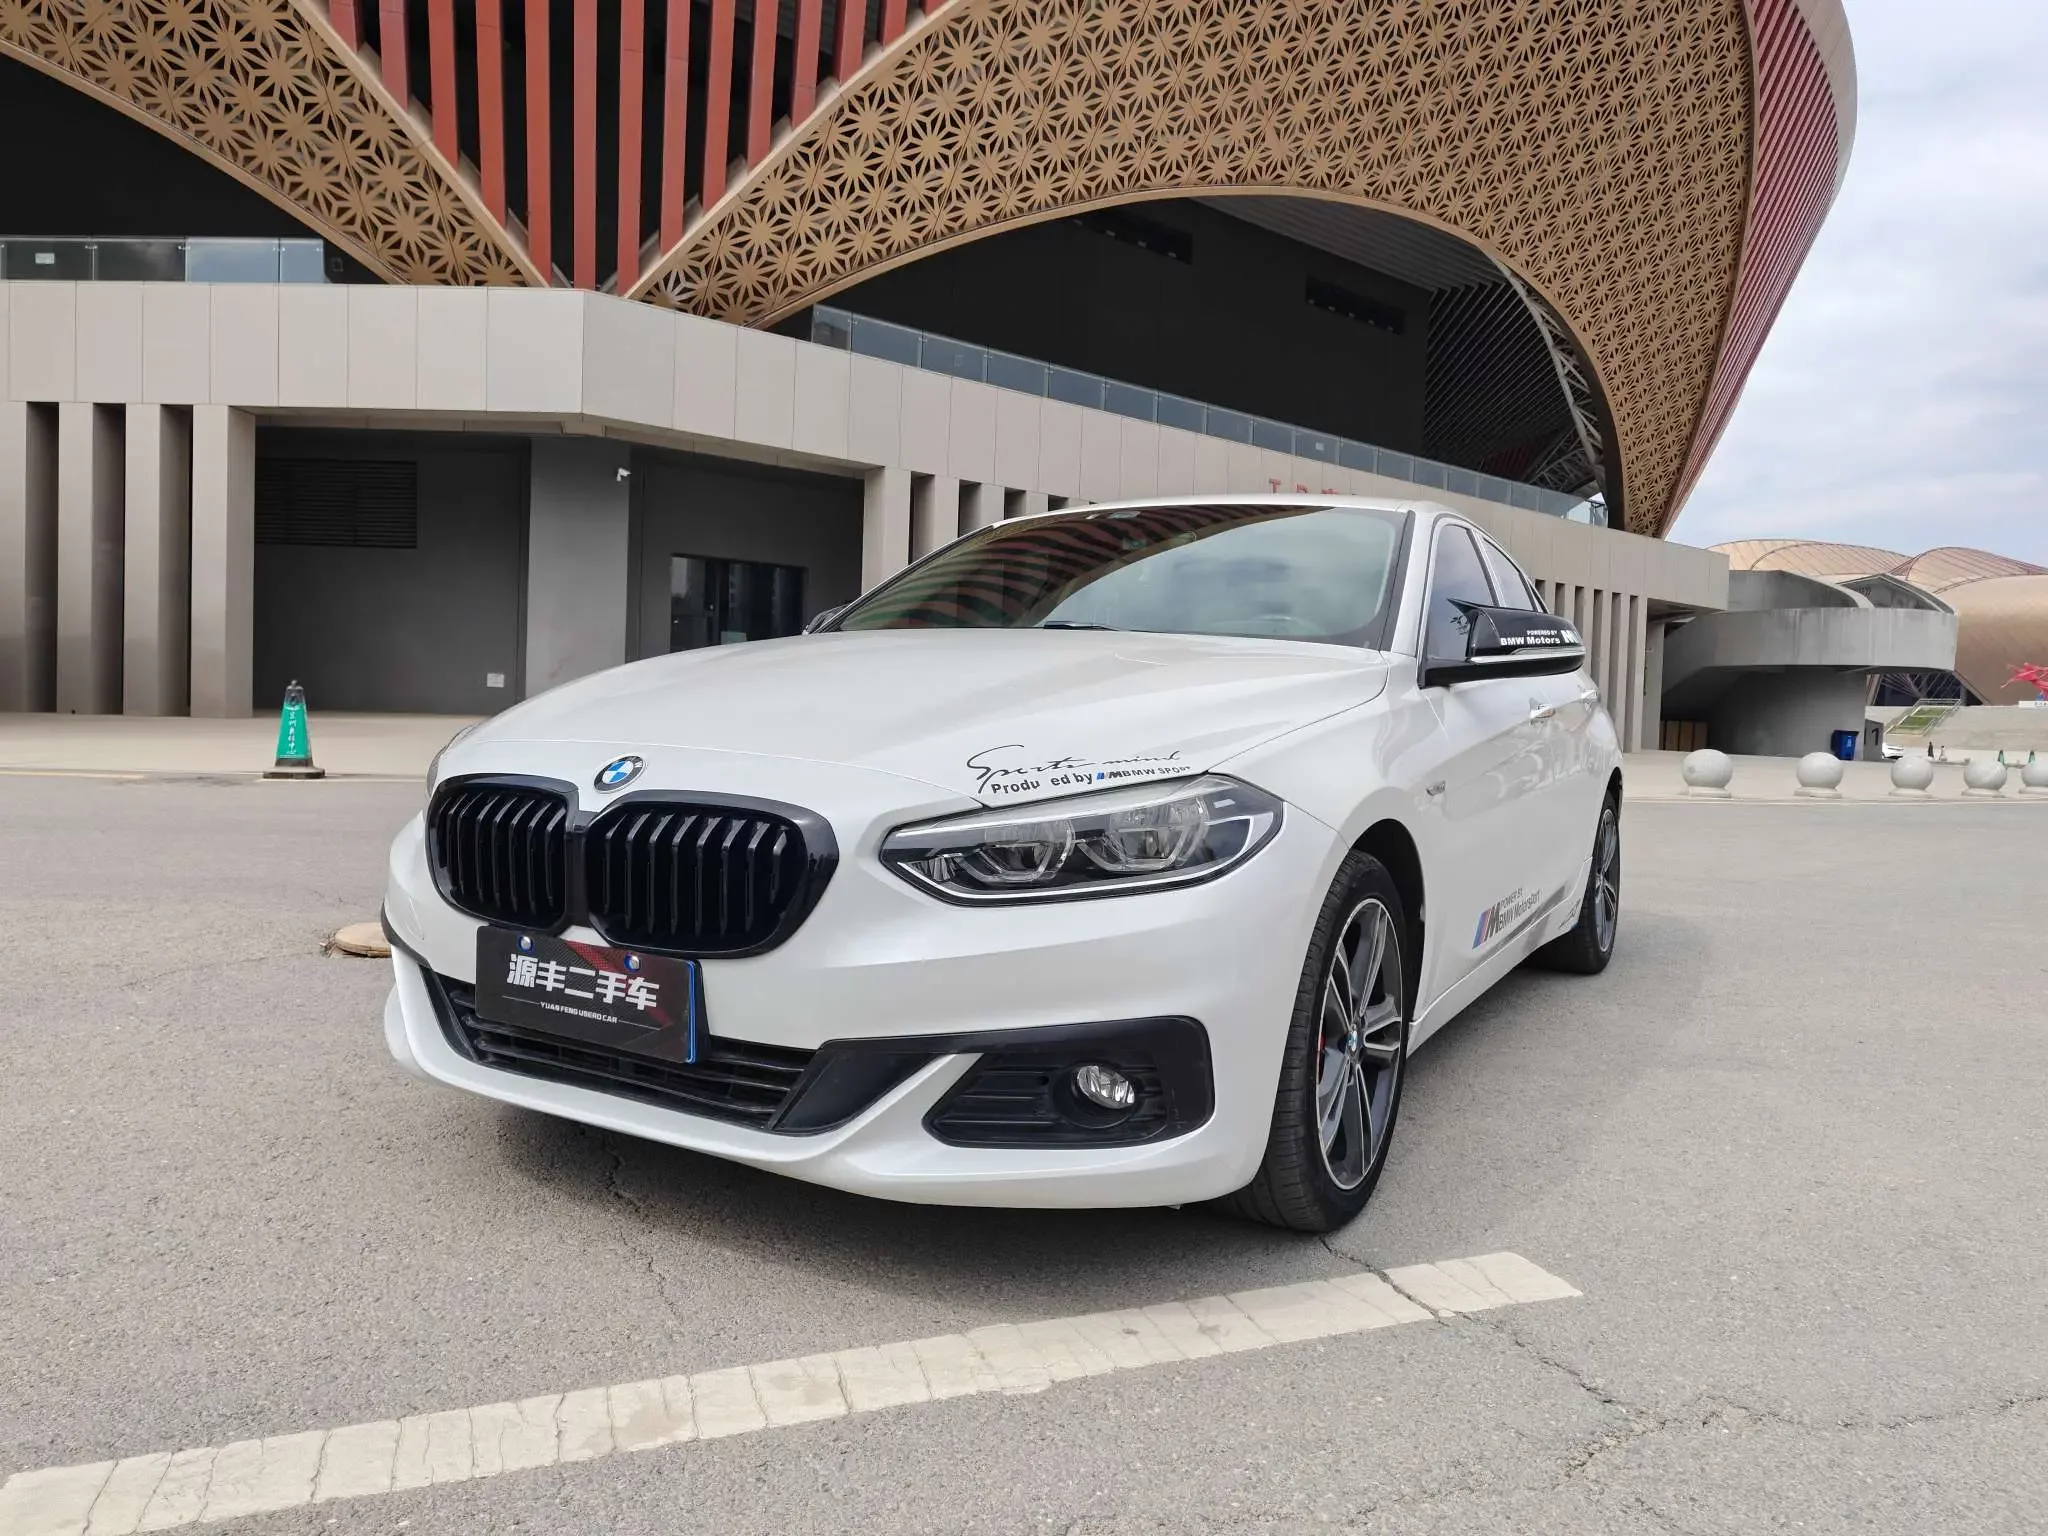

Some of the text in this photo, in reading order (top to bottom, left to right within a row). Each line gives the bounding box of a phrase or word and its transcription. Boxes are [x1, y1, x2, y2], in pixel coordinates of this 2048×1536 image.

[1500, 637, 1525, 646] BMW
[1526, 636, 1561, 645] Motors
[1871, 727, 1880, 746] 1
[1072, 772, 1093, 785] by
[507, 953, 660, 1011] 源丰二手车
[540, 1001, 560, 1012] YUAN
[560, 1005, 578, 1016] FENG
[602, 1014, 618, 1024] CAR
